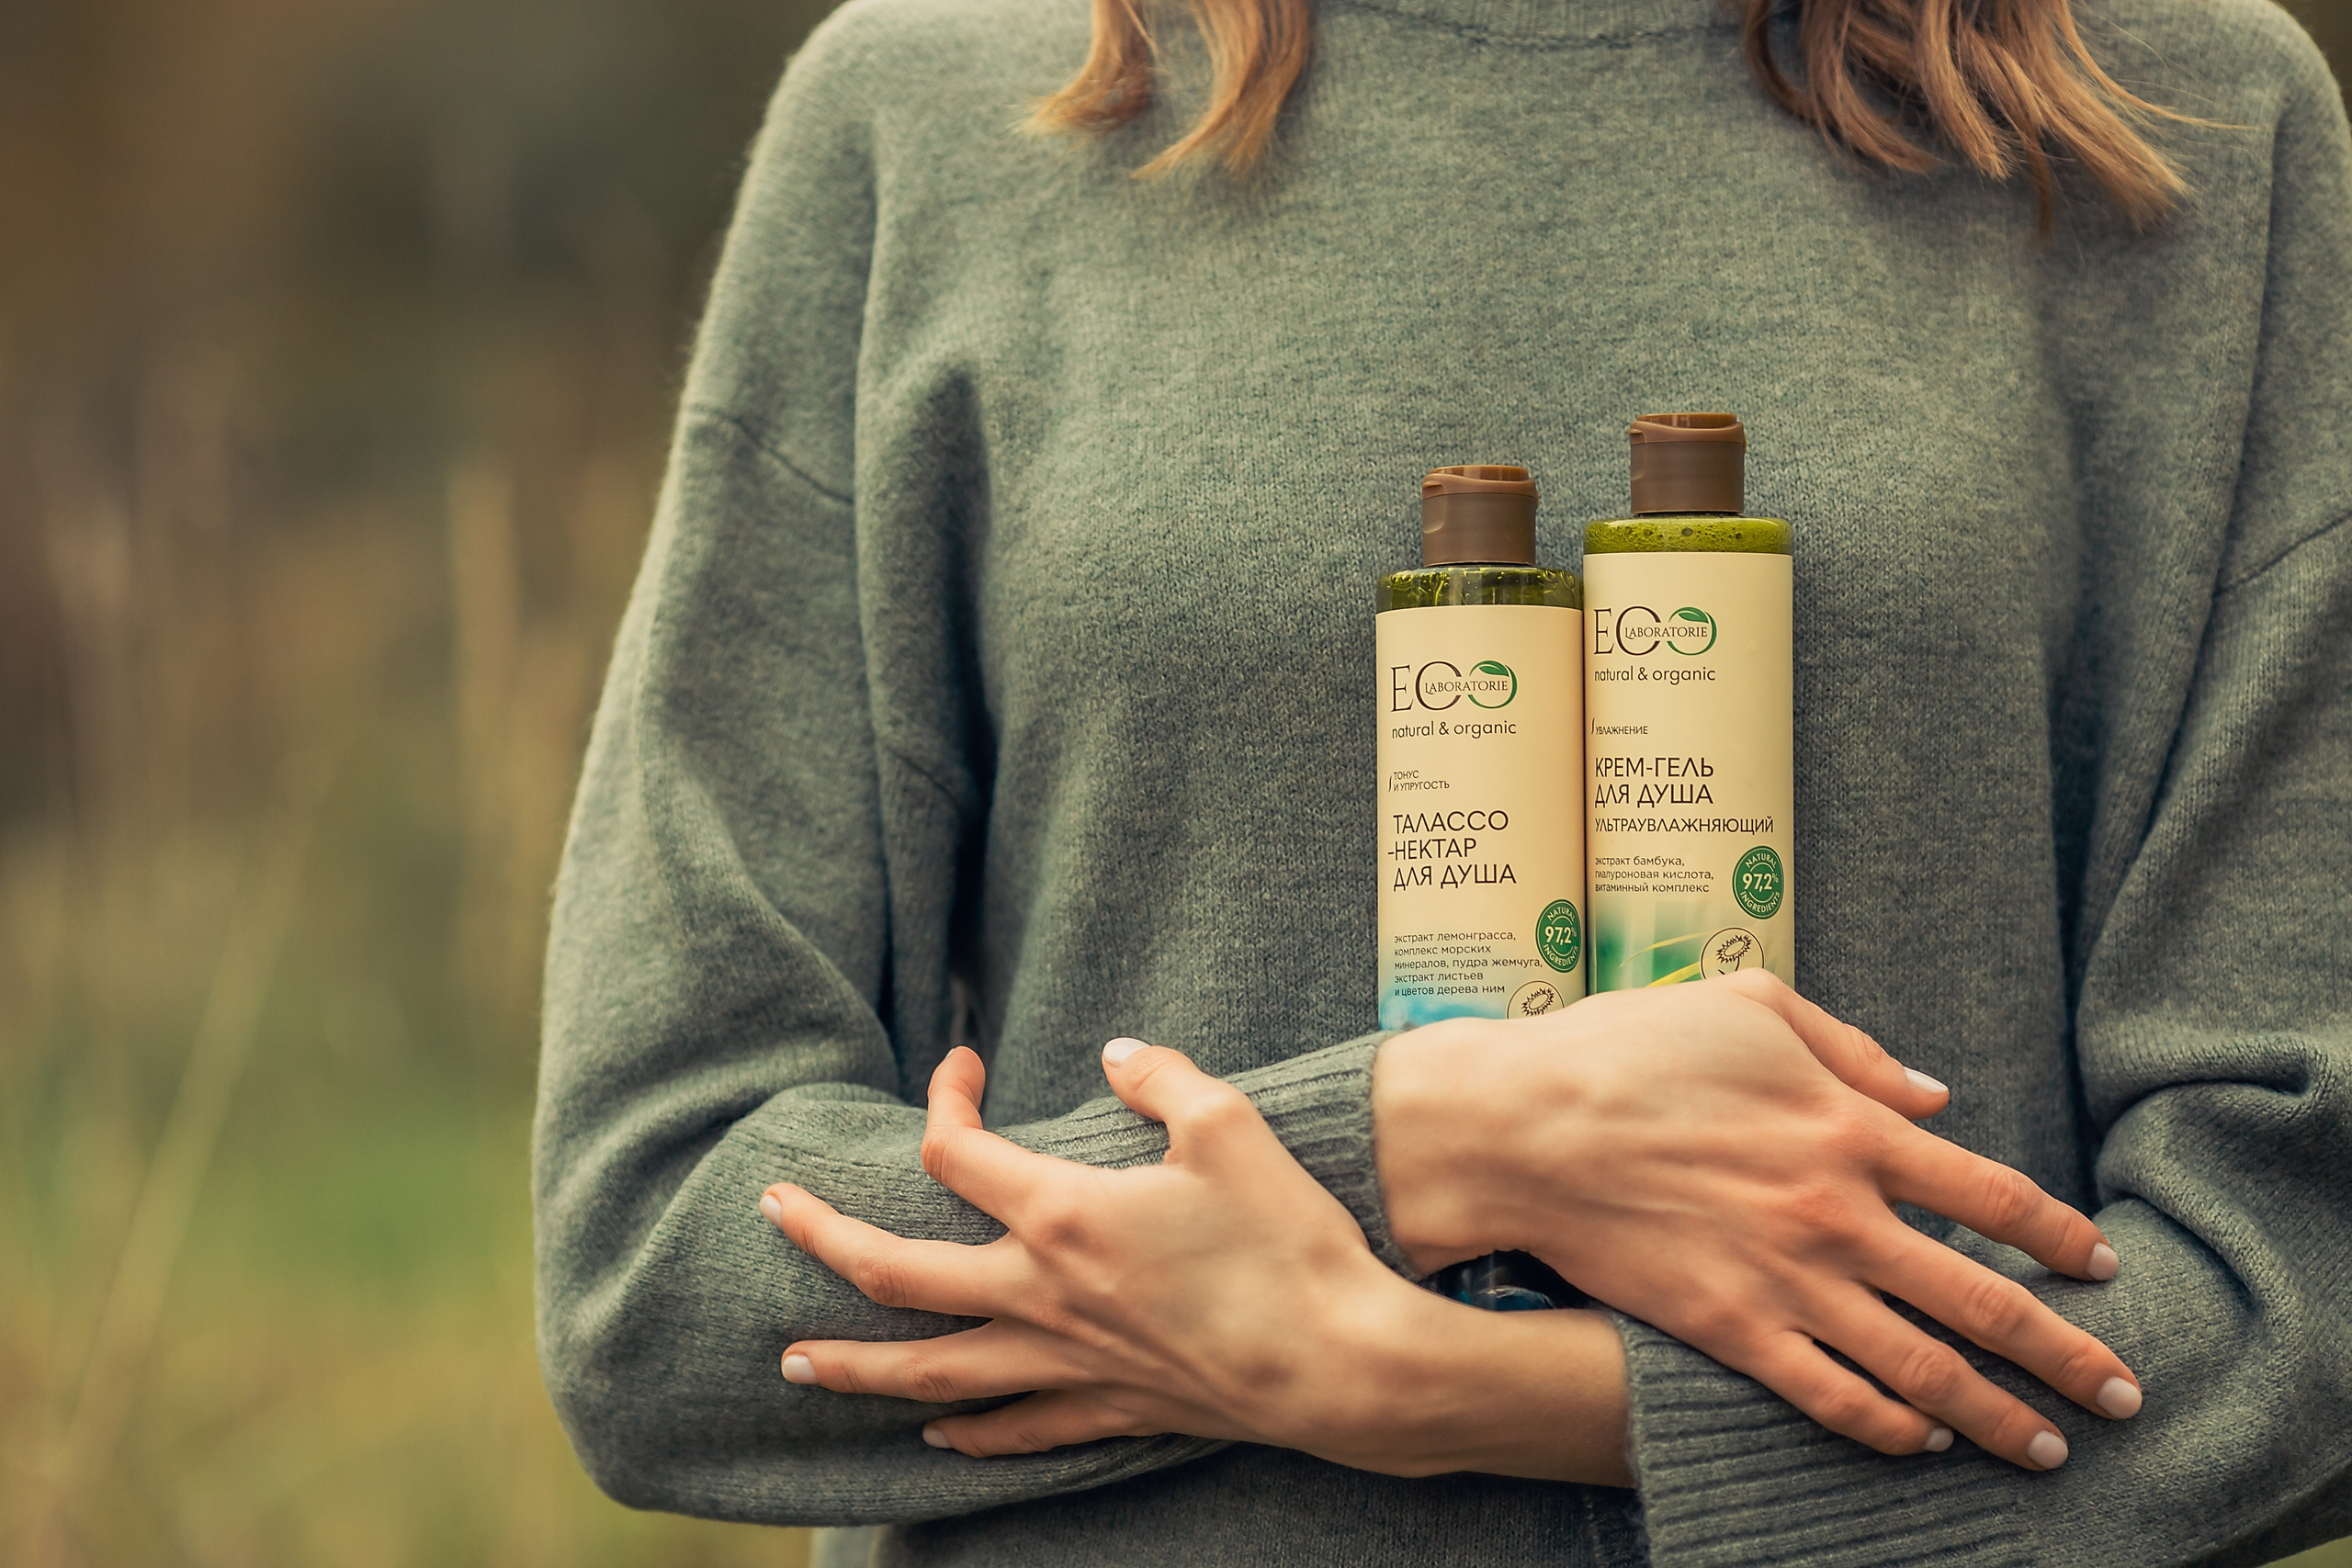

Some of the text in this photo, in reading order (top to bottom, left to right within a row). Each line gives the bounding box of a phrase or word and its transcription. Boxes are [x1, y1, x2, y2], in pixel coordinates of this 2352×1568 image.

[1593, 605, 1717, 656] ECO
[1624, 626, 1708, 640] LABORATORIE
[1594, 665, 1716, 685] natural & organic
[1390, 660, 1518, 713] ECO
[1425, 680, 1509, 695] LABORATORIE
[1392, 720, 1517, 739] natural & organic
[1595, 725, 1648, 736] УВЛАЖНЕНИЕ
[1393, 770, 1419, 781] ТОНУС
[1595, 757, 1714, 778] КРЕМ-ГЕЛЬ
[1393, 781, 1450, 792] И УПРУГОСТЬ
[1595, 784, 1714, 808] ДЛЯ ДУША
[1393, 810, 1510, 834] ТАЛАССО
[1595, 816, 1774, 836] УЛЬТРАУВЛАЖНЯЮЩИЙ
[1387, 838, 1477, 861] -НЕКТАР
[1595, 855, 1685, 868] экстракт бамбука,
[1746, 852, 1777, 869] NATURAL
[1393, 863, 1517, 892] ДЛЯ ДУША
[1595, 869, 1714, 881] гиалуроновая кислота,
[1742, 873, 1779, 893] 97,2%
[1595, 882, 1710, 894] витаминный комплекс
[1740, 891, 1781, 913] INGREDIENTS
[1546, 907, 1576, 922] NATURAL
[1394, 931, 1516, 945] экстракт лемонграсса,
[1544, 925, 1577, 946] 97,2%
[1394, 944, 1492, 958] комплекс морских
[1543, 943, 1578, 967] INGREDIENTS
[1394, 957, 1543, 972] минералов, пудра жемчуга,
[1394, 971, 1484, 985] экстракт листьев
[1394, 984, 1506, 998] и цветов дерева ним
